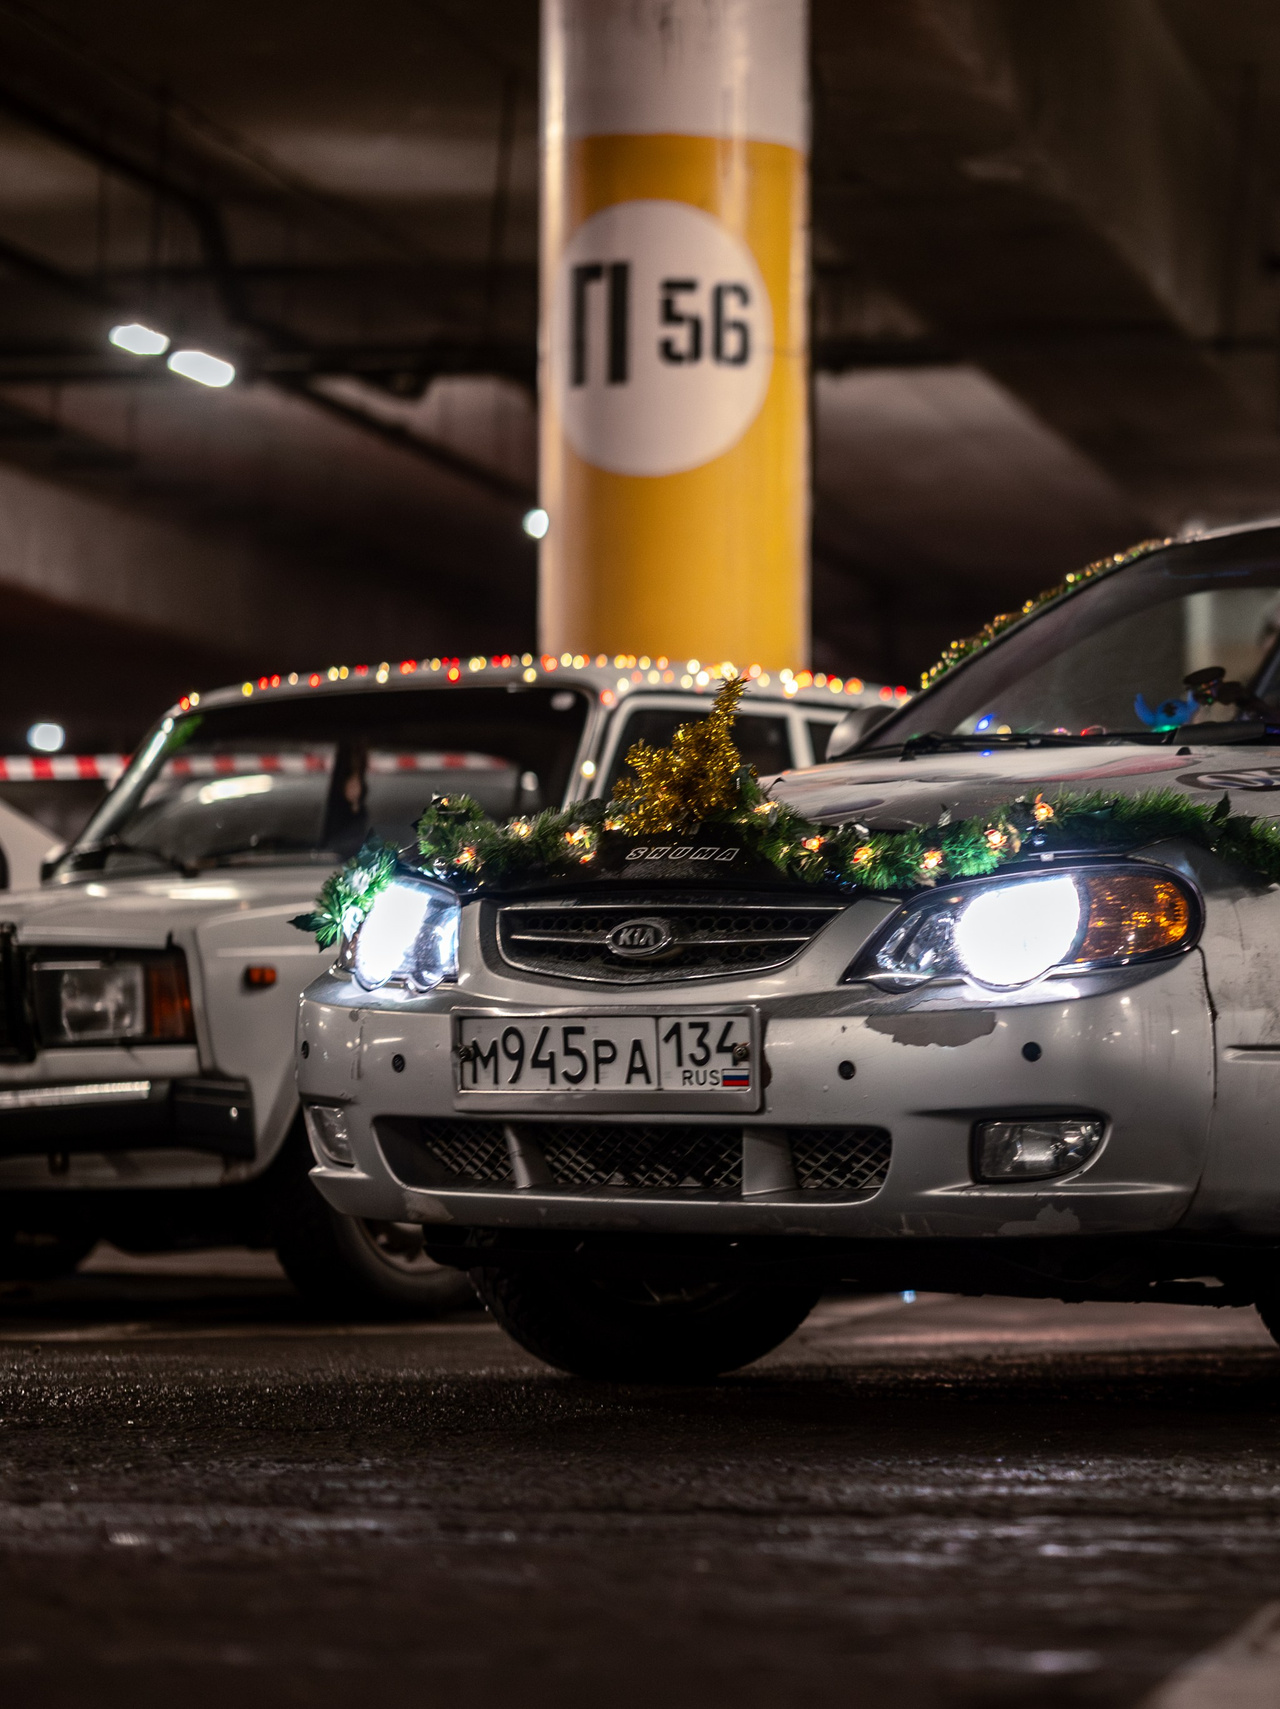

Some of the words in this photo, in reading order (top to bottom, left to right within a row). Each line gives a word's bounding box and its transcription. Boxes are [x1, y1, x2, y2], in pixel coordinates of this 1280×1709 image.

[570, 260, 629, 388] П
[658, 278, 750, 368] 56
[625, 846, 741, 862] SHUMA
[618, 928, 656, 946] KIA
[663, 1021, 742, 1068] 134
[682, 1069, 720, 1087] RUS
